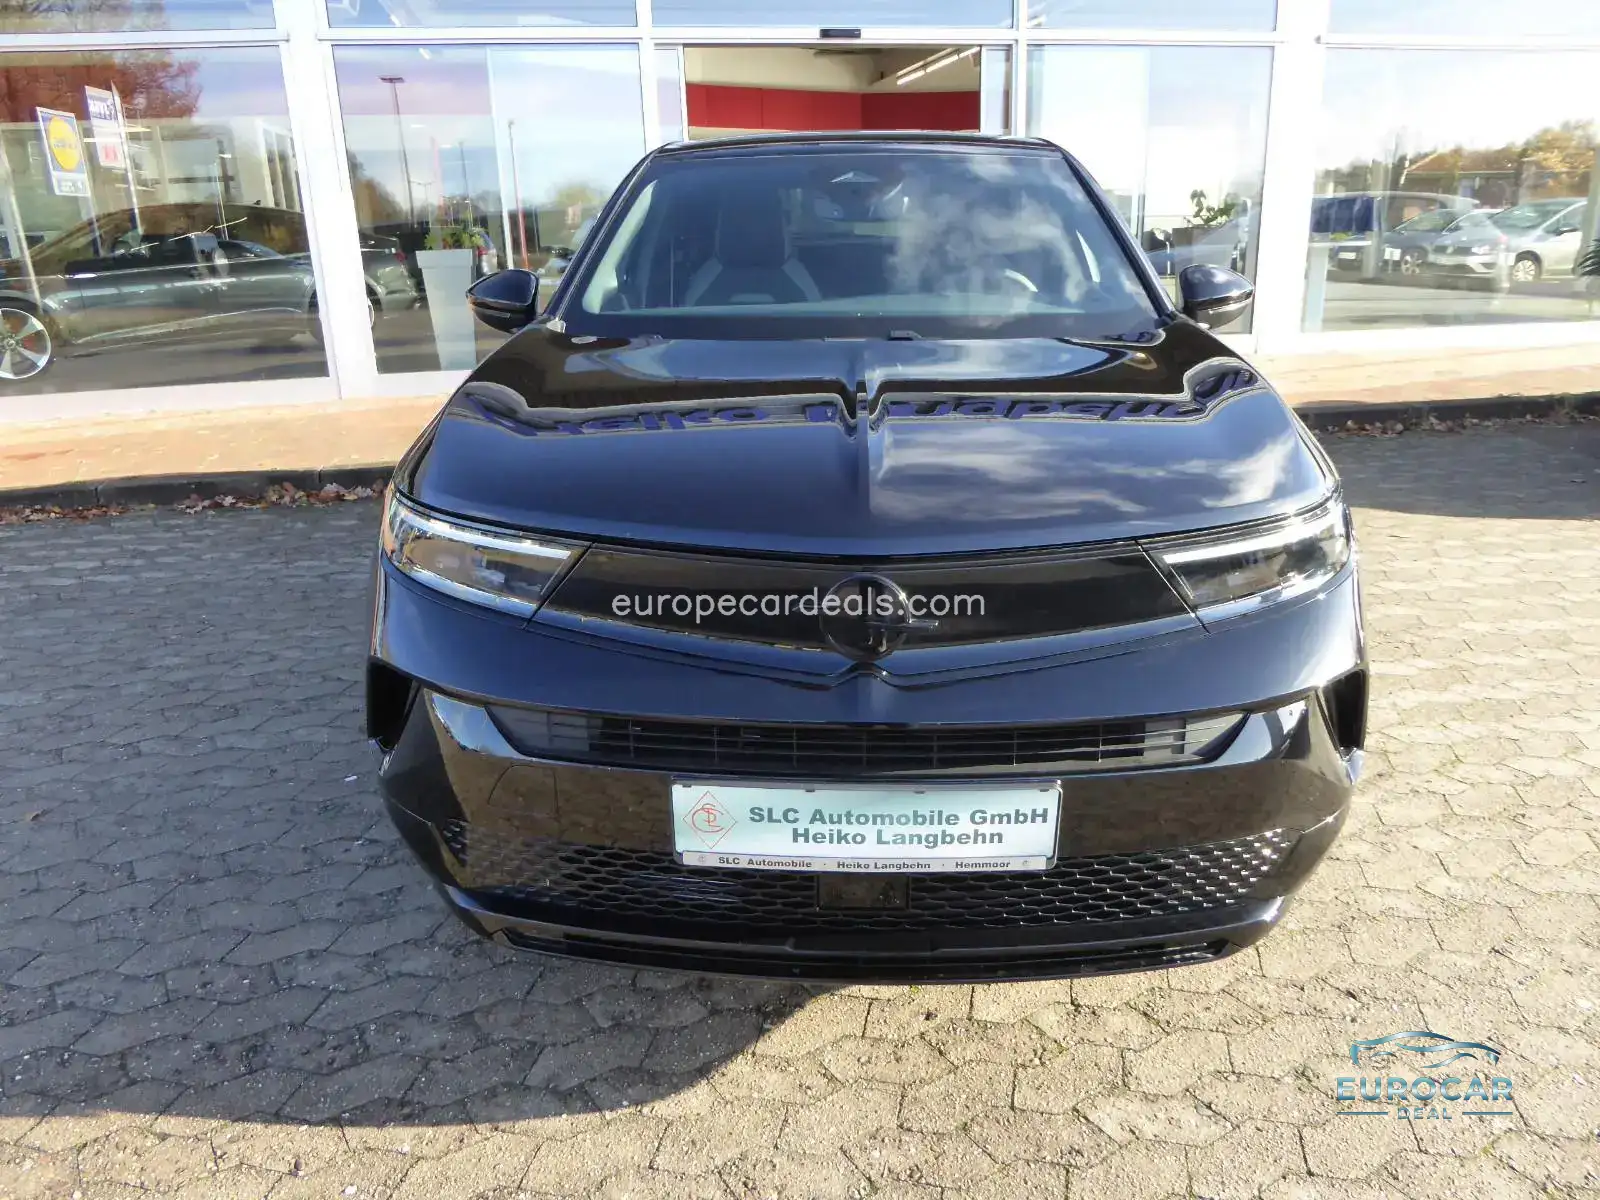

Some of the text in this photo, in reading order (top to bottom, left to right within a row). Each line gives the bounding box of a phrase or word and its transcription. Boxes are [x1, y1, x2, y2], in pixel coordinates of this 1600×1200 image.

[749, 807, 1049, 826] SLC Automobile GmbH
[792, 828, 1004, 850] Heiko Langbehn
[718, 856, 1011, 871] SLC Automobile Heiko Langbehn Hemmoor
